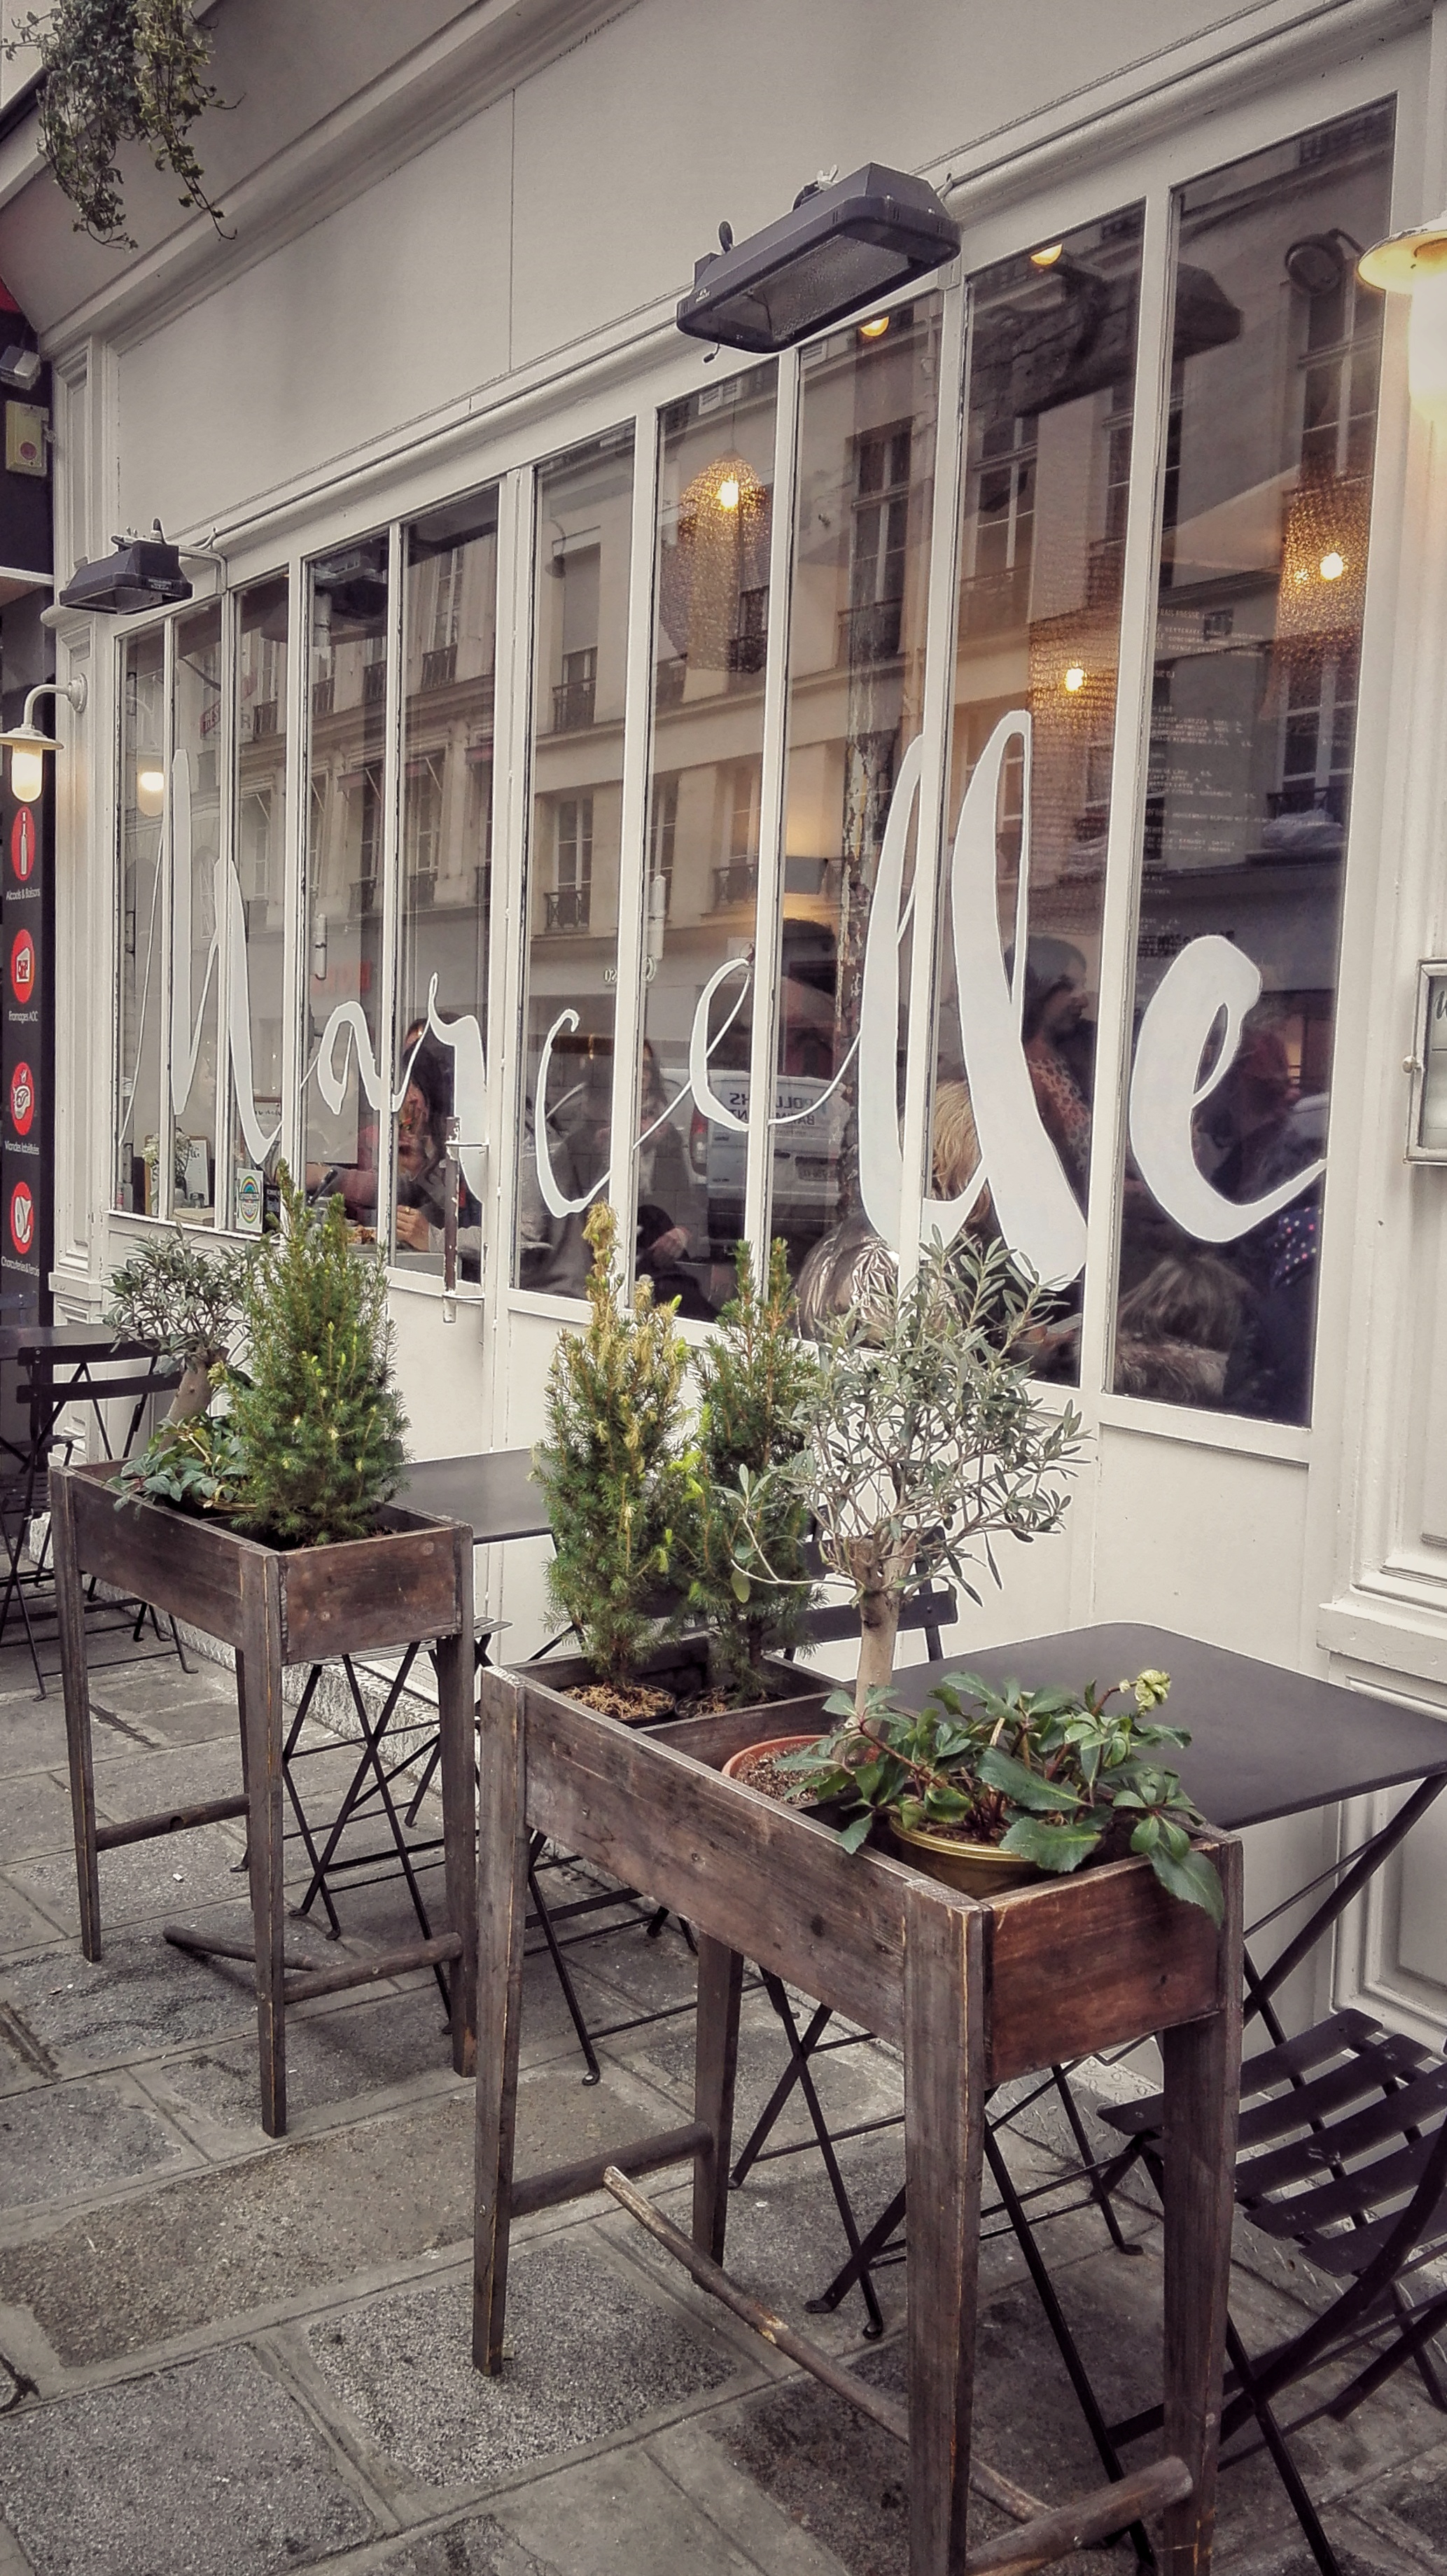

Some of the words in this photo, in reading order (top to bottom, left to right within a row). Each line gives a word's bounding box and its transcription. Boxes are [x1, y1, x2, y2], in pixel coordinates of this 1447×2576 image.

[9, 1010, 29, 1024] Fromages
[29, 1010, 39, 1022] AOC
[118, 709, 1327, 1291] Marcelle
